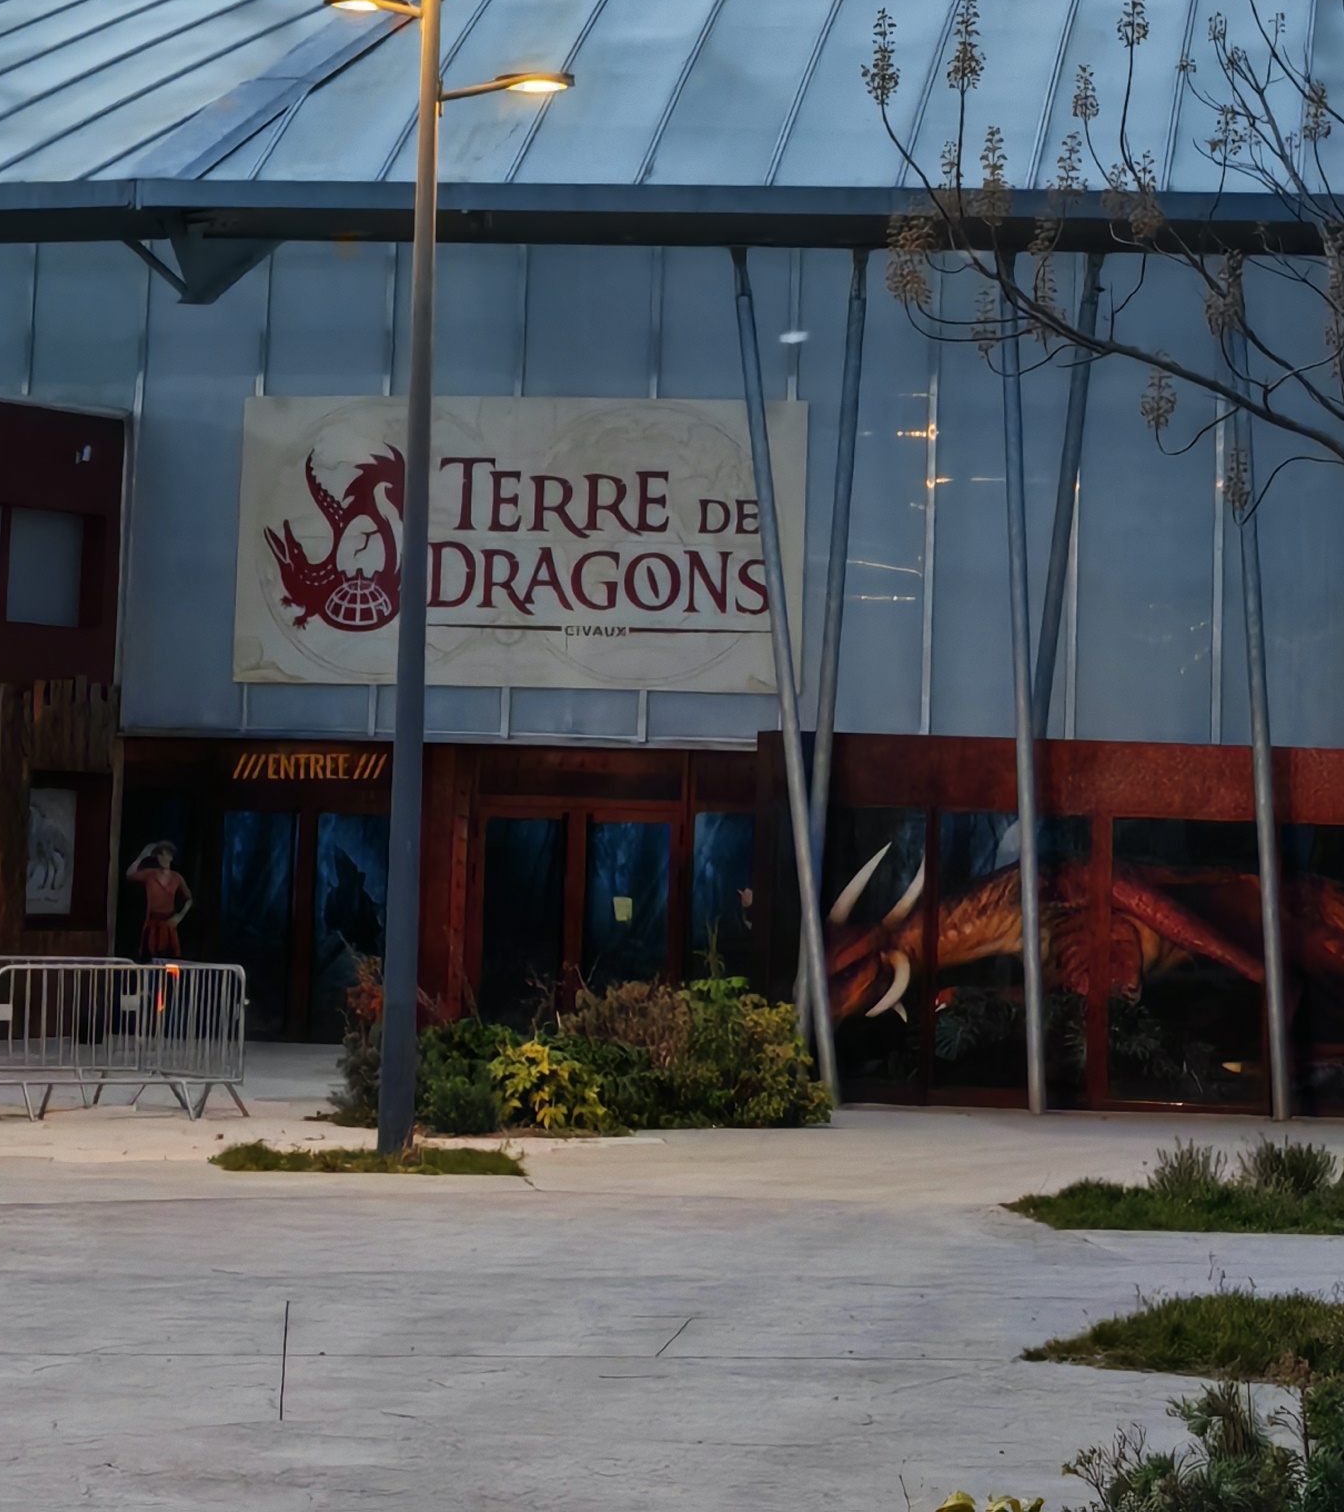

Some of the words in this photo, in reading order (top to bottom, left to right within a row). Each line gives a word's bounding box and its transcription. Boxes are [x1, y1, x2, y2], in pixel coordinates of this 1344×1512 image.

[439, 457, 670, 539] TERRE
[698, 499, 760, 534] DE
[427, 541, 769, 615] DRAGONS
[564, 625, 627, 637] CIVAUX
